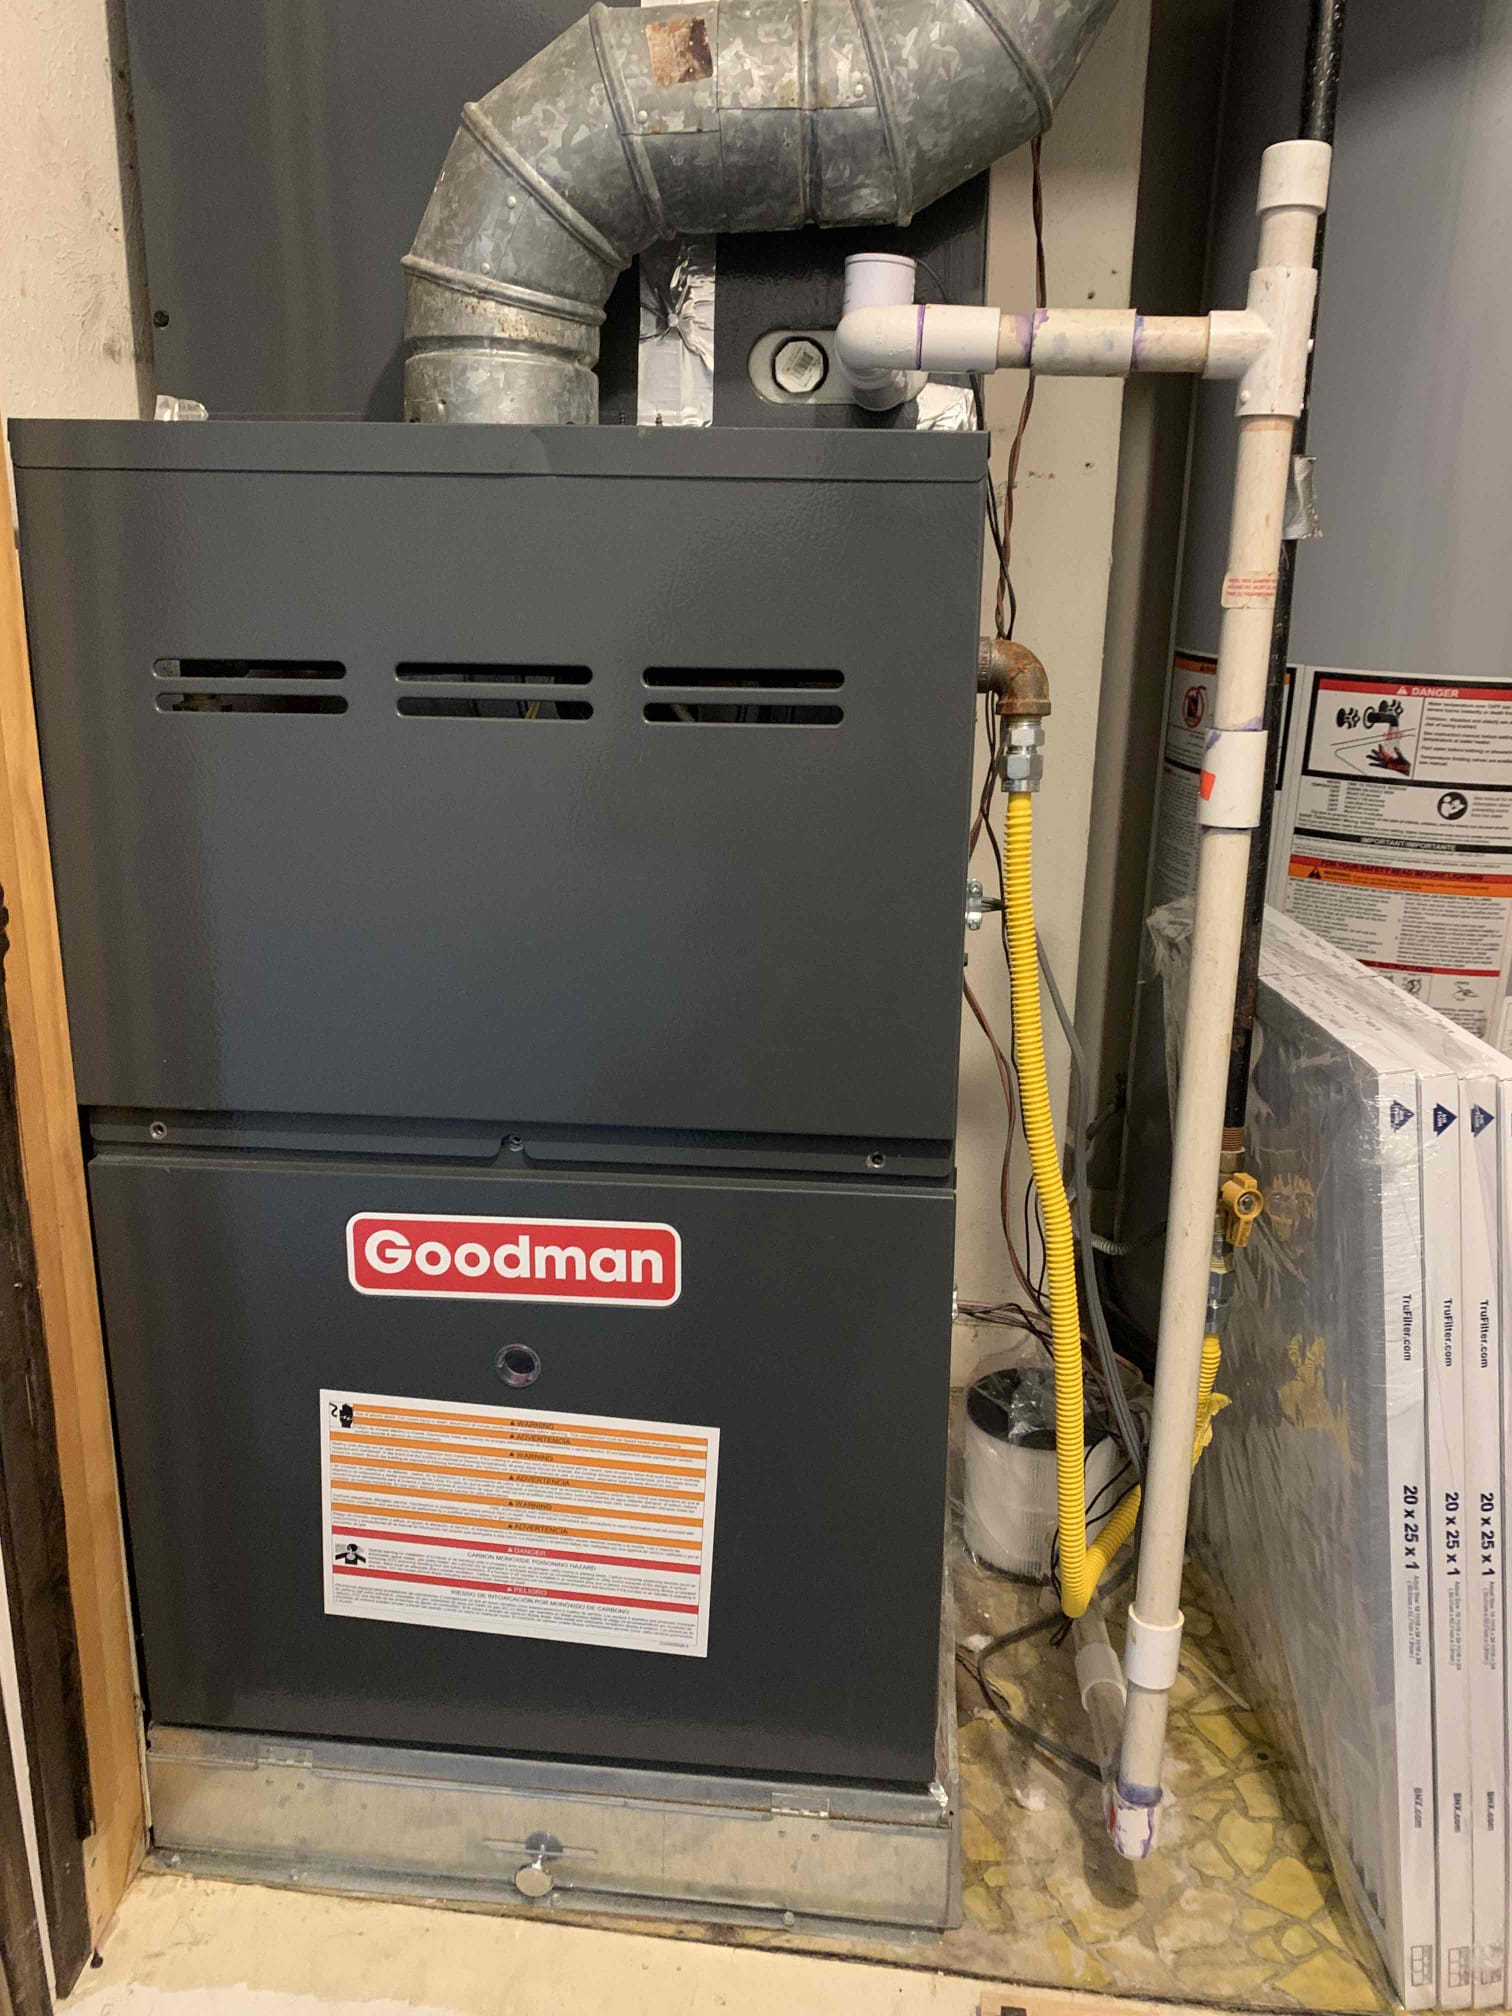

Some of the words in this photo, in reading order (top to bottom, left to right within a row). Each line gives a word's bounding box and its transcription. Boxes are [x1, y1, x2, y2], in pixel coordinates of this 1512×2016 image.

[1412, 688, 1459, 697] DANGER
[365, 1230, 663, 1283] Goodman
[1402, 1294, 1412, 1361] TruFilter.com
[1443, 1299, 1453, 1367] TruFilter.com
[1479, 1300, 1489, 1368] TruFilter.com
[517, 1420, 554, 1430] WARNING
[516, 1433, 571, 1445] ADVERTENCIA
[516, 1452, 554, 1462] WARNING
[516, 1475, 570, 1486] ADVERTENCIA
[1403, 1485, 1418, 1505] 20
[515, 1501, 552, 1511] WARNING
[1445, 1492, 1459, 1511] 20
[1480, 1493, 1494, 1512] 20
[1404, 1509, 1415, 1518] x
[1446, 1516, 1455, 1525] x
[1481, 1517, 1491, 1526] x
[514, 1524, 568, 1535] ADVERTENCIA
[1405, 1523, 1419, 1542] 25
[1446, 1530, 1460, 1549] 25
[1481, 1531, 1495, 1550] 25
[514, 1547, 546, 1556] DANGER
[1405, 1547, 1416, 1556] x
[467, 1551, 494, 1560] CARBON
[495, 1554, 530, 1564] MONOXIDE
[531, 1558, 568, 1568] POISONING
[570, 1563, 596, 1571] HAZARD
[1447, 1554, 1457, 1562] x
[1482, 1554, 1492, 1563] x
[1406, 1562, 1420, 1570] 1
[514, 1587, 547, 1596] PELIGRO
[451, 1589, 475, 1598] RIESGO
[597, 1605, 629, 1614] CARBONO
